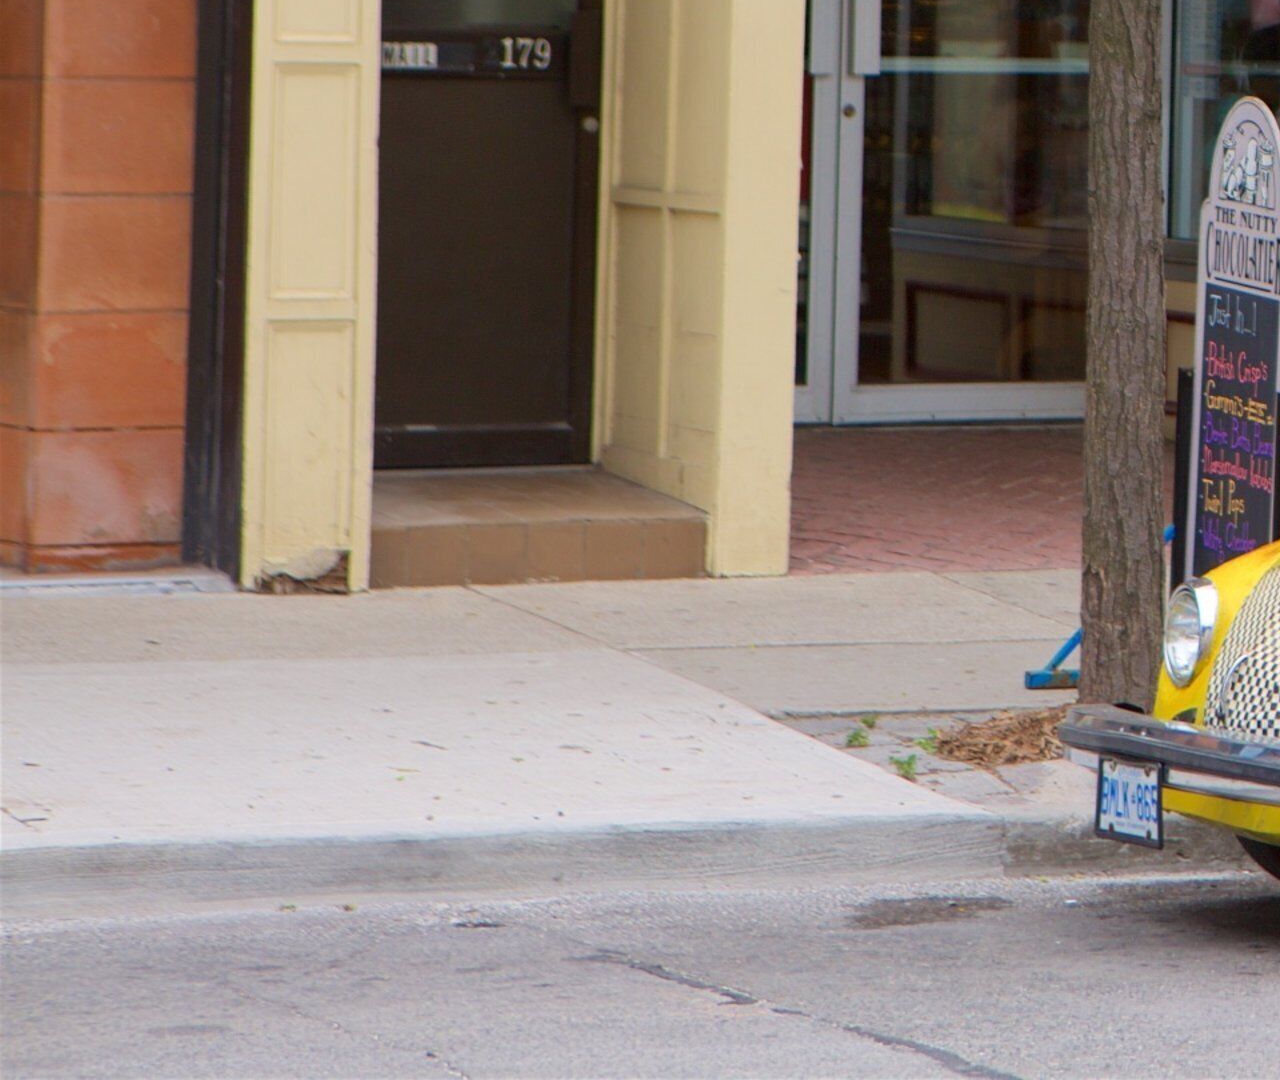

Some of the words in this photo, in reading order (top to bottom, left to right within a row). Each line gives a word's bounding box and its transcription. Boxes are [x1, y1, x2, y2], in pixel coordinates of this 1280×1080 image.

[501, 36, 552, 69] 179
[1214, 204, 1237, 227] THE
[1240, 210, 1278, 234] NUTTY
